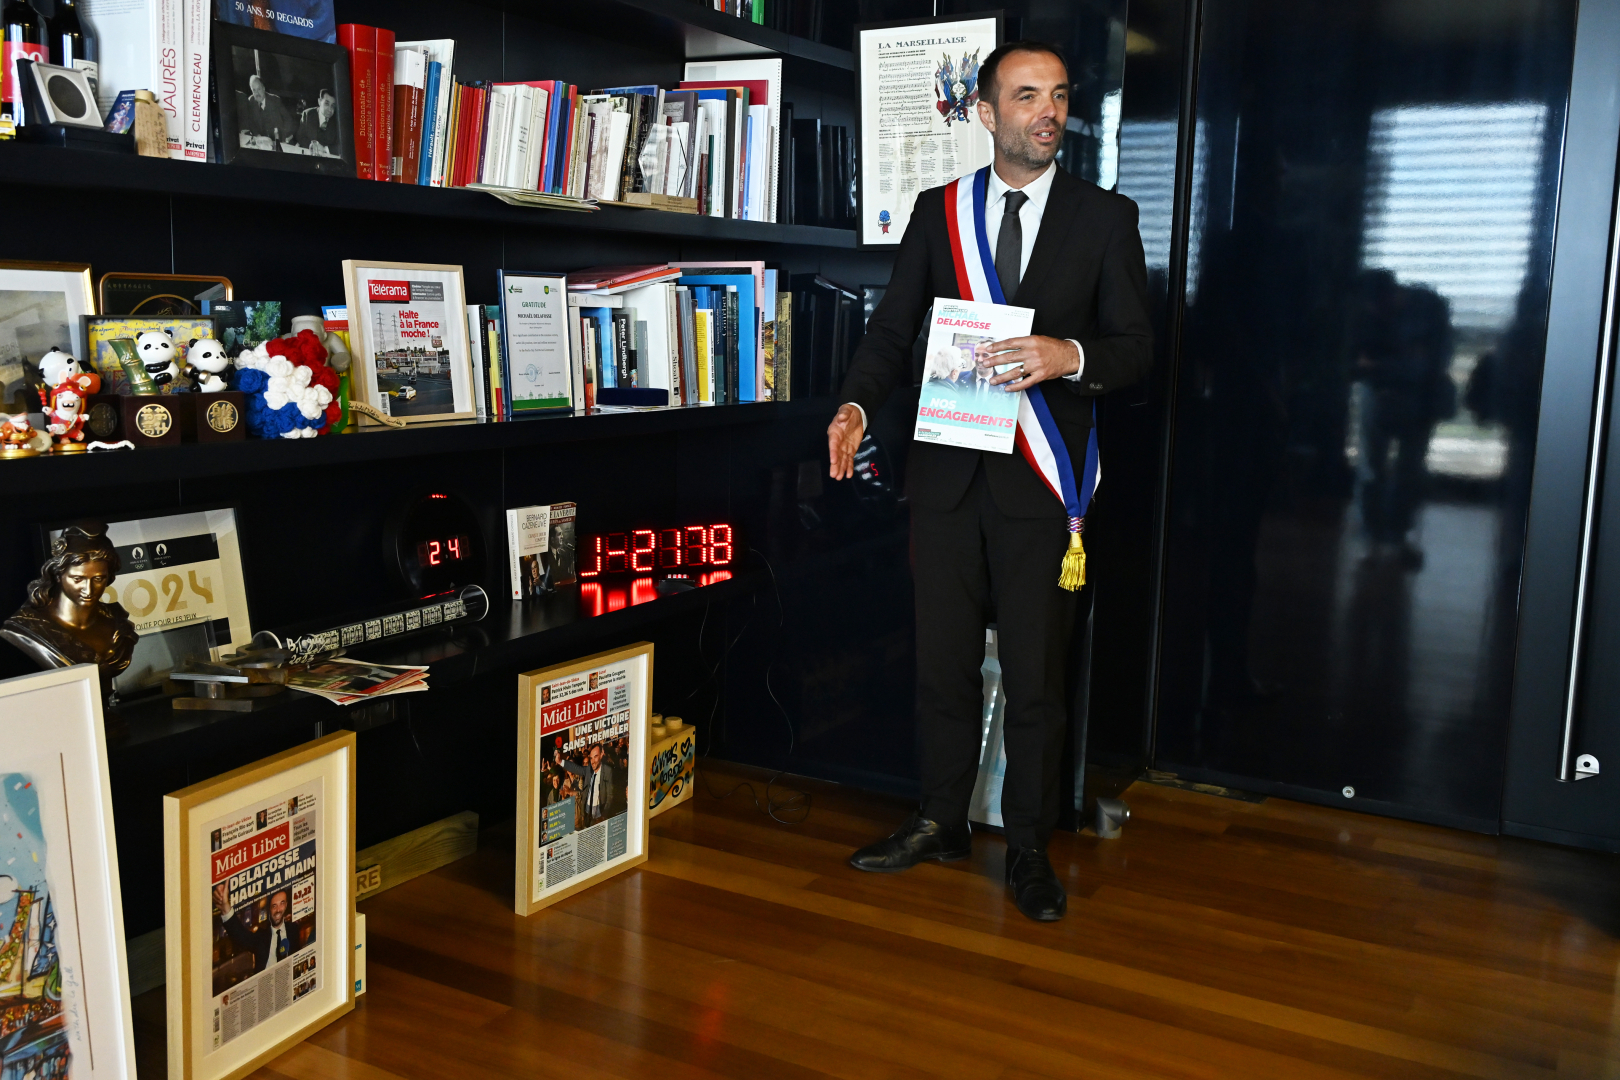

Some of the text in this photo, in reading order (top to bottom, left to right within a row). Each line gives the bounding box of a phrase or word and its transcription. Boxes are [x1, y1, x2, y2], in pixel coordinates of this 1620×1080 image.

[235, 2, 314, 28] 50 ANS, 50 REGARDS
[896, 36, 967, 48] MARSEILLAISE
[160, 48, 177, 118] JAURÈS
[360, 80, 365, 89] de
[380, 83, 385, 91] de
[192, 53, 202, 132] CLEMENCEAU
[186, 142, 205, 150] Privat
[369, 283, 407, 296] Télérama
[399, 310, 419, 319] Halte
[938, 310, 979, 321] MICHAËL
[400, 319, 439, 329] à la France
[936, 318, 991, 330] DELAFOSSE
[401, 329, 427, 338] moche
[930, 398, 956, 410] NOS
[919, 407, 1014, 428] ENGAGEMENTS
[526, 513, 548, 522] BERNARD
[522, 520, 547, 530] CAZENEUVE
[134, 613, 197, 631] OUTE POUR LES JEUX
[542, 698, 606, 728] Midi Libre
[575, 711, 630, 737] UNE VICTOIRE
[563, 724, 629, 754] SANS TREMBLER
[223, 827, 239, 837] François
[223, 836, 237, 844] Isabelle
[215, 834, 286, 876] Midi Libre
[230, 848, 300, 892] DELAFOSSE
[230, 855, 316, 908] HAUT LA MAIN
